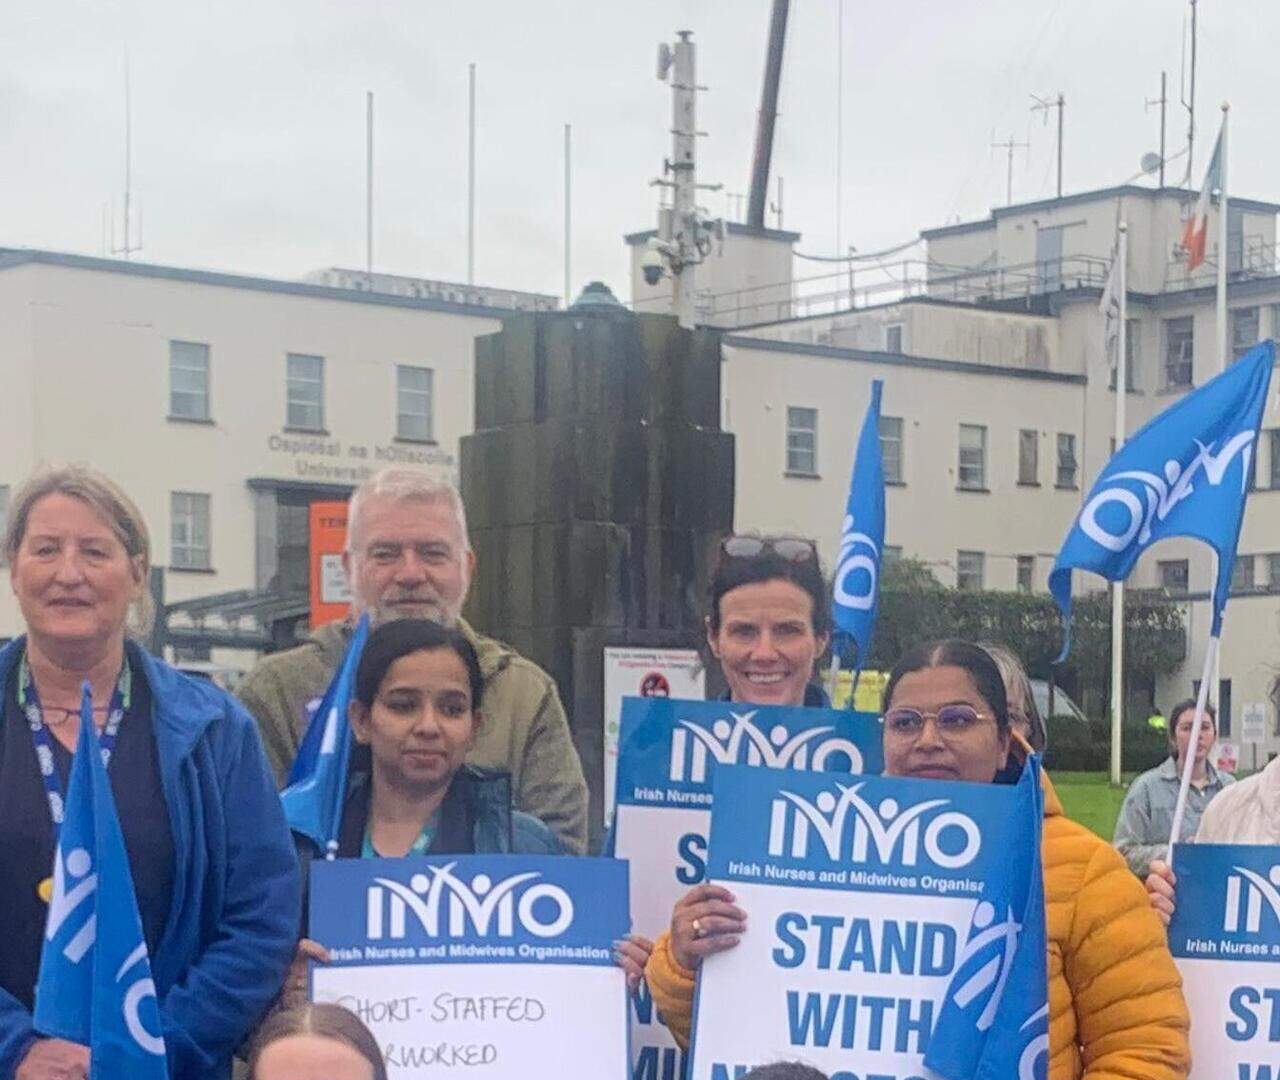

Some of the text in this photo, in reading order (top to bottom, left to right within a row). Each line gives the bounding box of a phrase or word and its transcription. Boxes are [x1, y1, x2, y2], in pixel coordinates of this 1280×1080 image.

[670, 709, 863, 782] INMO
[634, 787, 713, 804] Irish Nurses
[767, 780, 982, 868] INMO
[367, 862, 574, 940] INMO
[728, 862, 984, 893] Irish Nurses and Midwives Organis
[331, 944, 609, 961] Irish Nurses and Midwives Organisation
[773, 912, 957, 977] STAND
[1186, 939, 1217, 953] Irish
[1220, 940, 1268, 955] Nurses
[786, 990, 933, 1055] WITH
[384, 1042, 498, 1068] RWORKED
